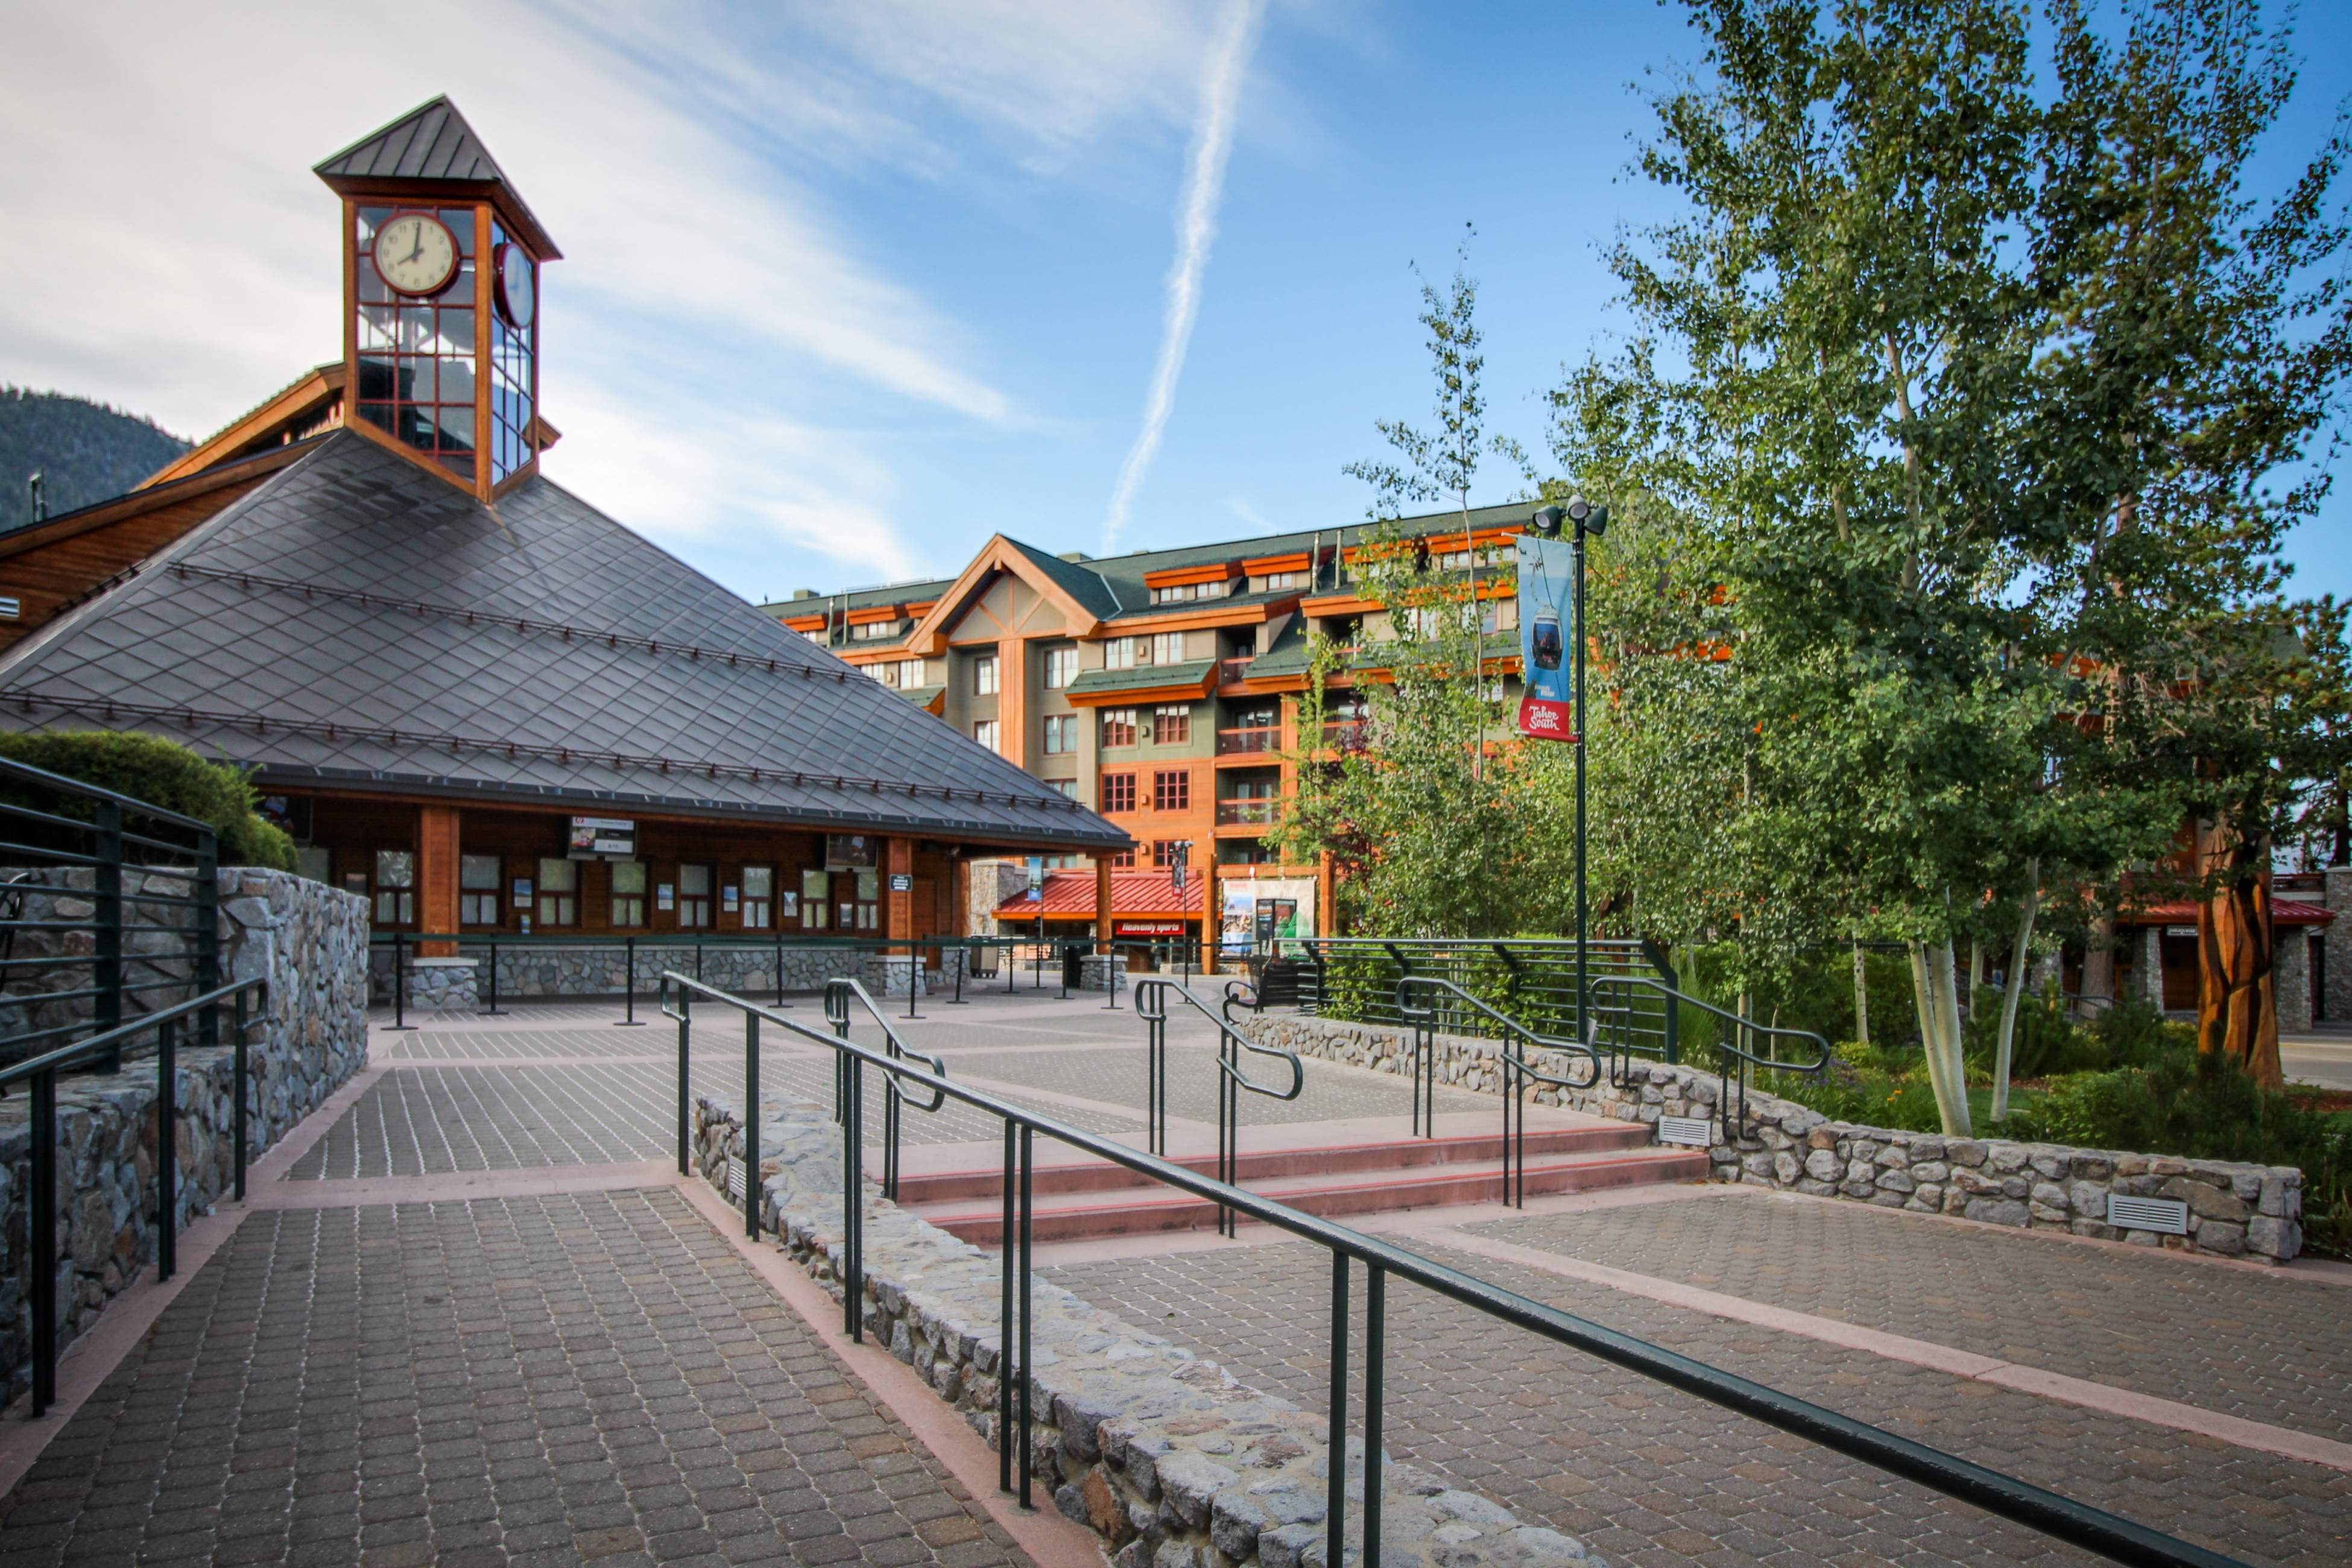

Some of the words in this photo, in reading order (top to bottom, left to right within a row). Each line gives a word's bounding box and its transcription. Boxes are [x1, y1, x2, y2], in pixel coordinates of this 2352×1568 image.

[399, 225, 406, 233] 11
[388, 236, 397, 245] 10
[439, 236, 445, 245] 2
[400, 273, 405, 282] 7
[414, 279, 420, 288] 6
[1529, 706, 1559, 720] Tahoe
[1529, 716, 1560, 730] South
[1122, 923, 1155, 933] Heavenly
[1157, 924, 1179, 933] sports
